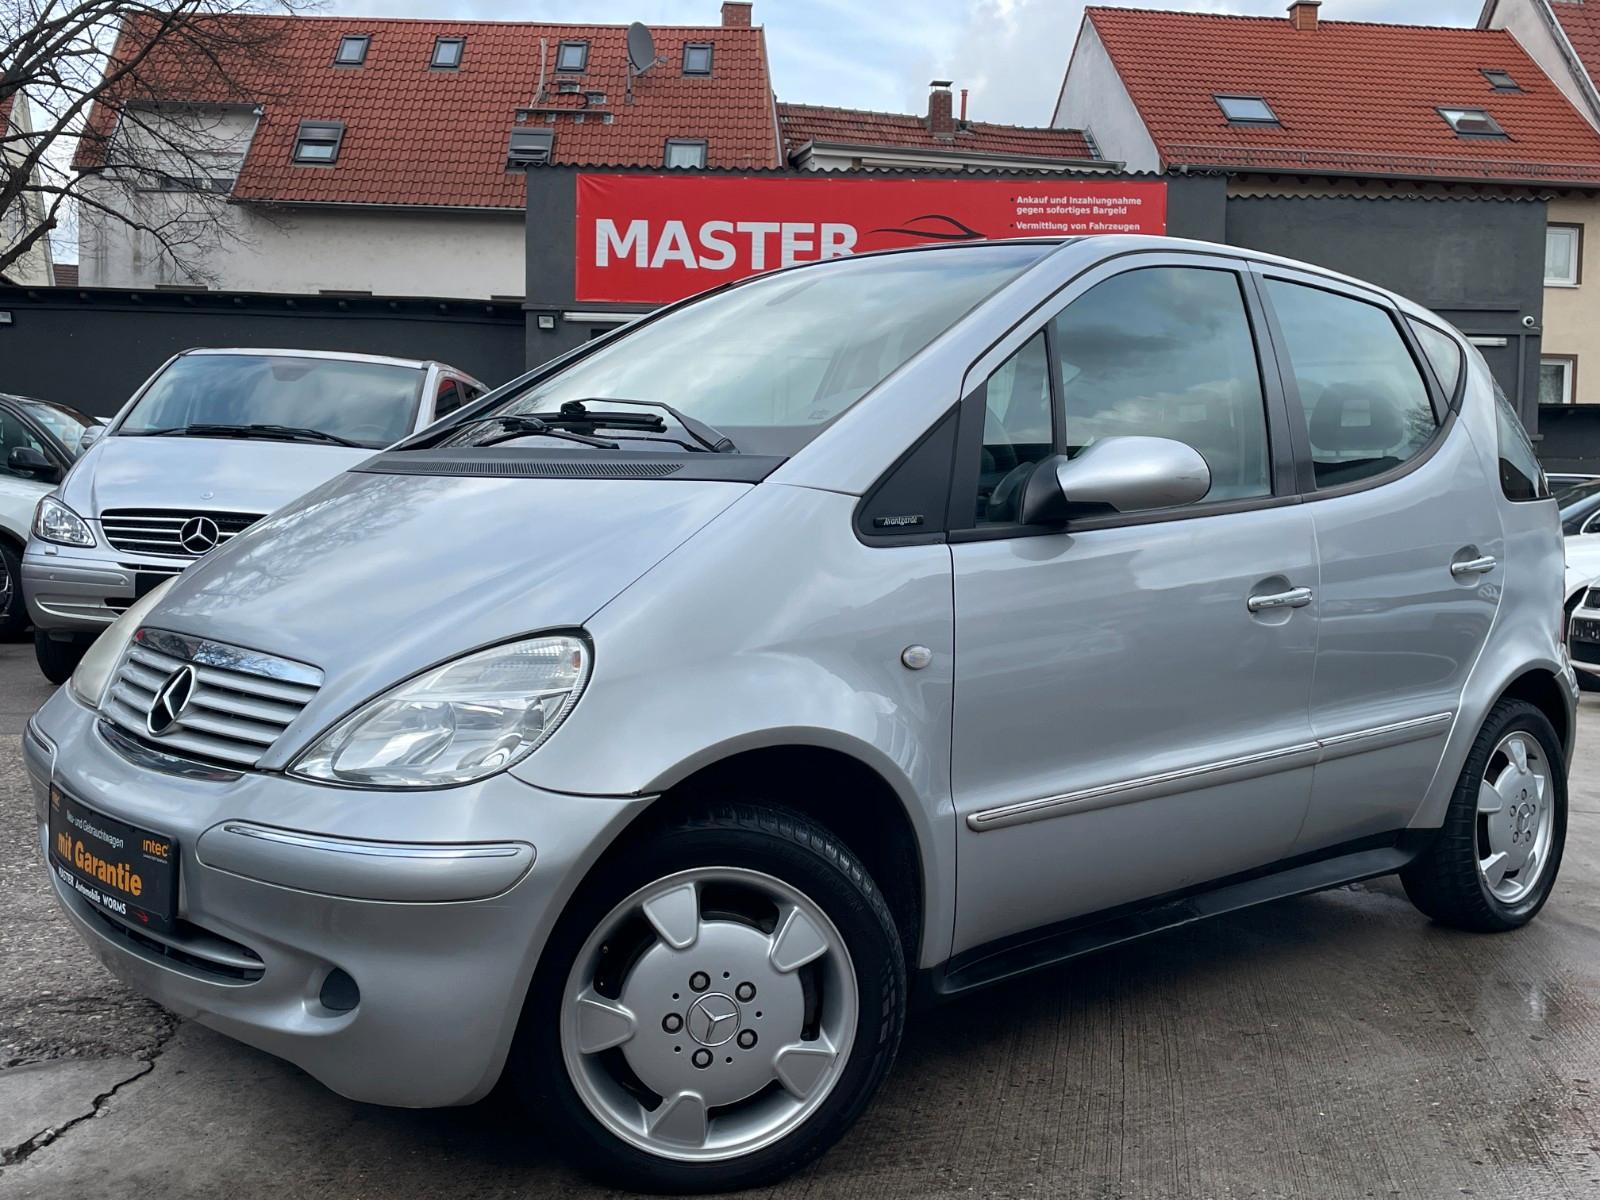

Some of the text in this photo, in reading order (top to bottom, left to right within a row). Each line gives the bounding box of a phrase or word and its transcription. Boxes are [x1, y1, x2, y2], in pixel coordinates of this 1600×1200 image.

[1016, 195, 1142, 206] Ankauf und Inzahlungnahme
[1016, 206, 1127, 216] gegen sofortiges Bargeld
[1016, 221, 1140, 231] Vermittlung von Fahrzeugen
[595, 218, 858, 271] MASTER
[58, 831, 142, 896] mit Garantie
[102, 893, 126, 915] WORMS
